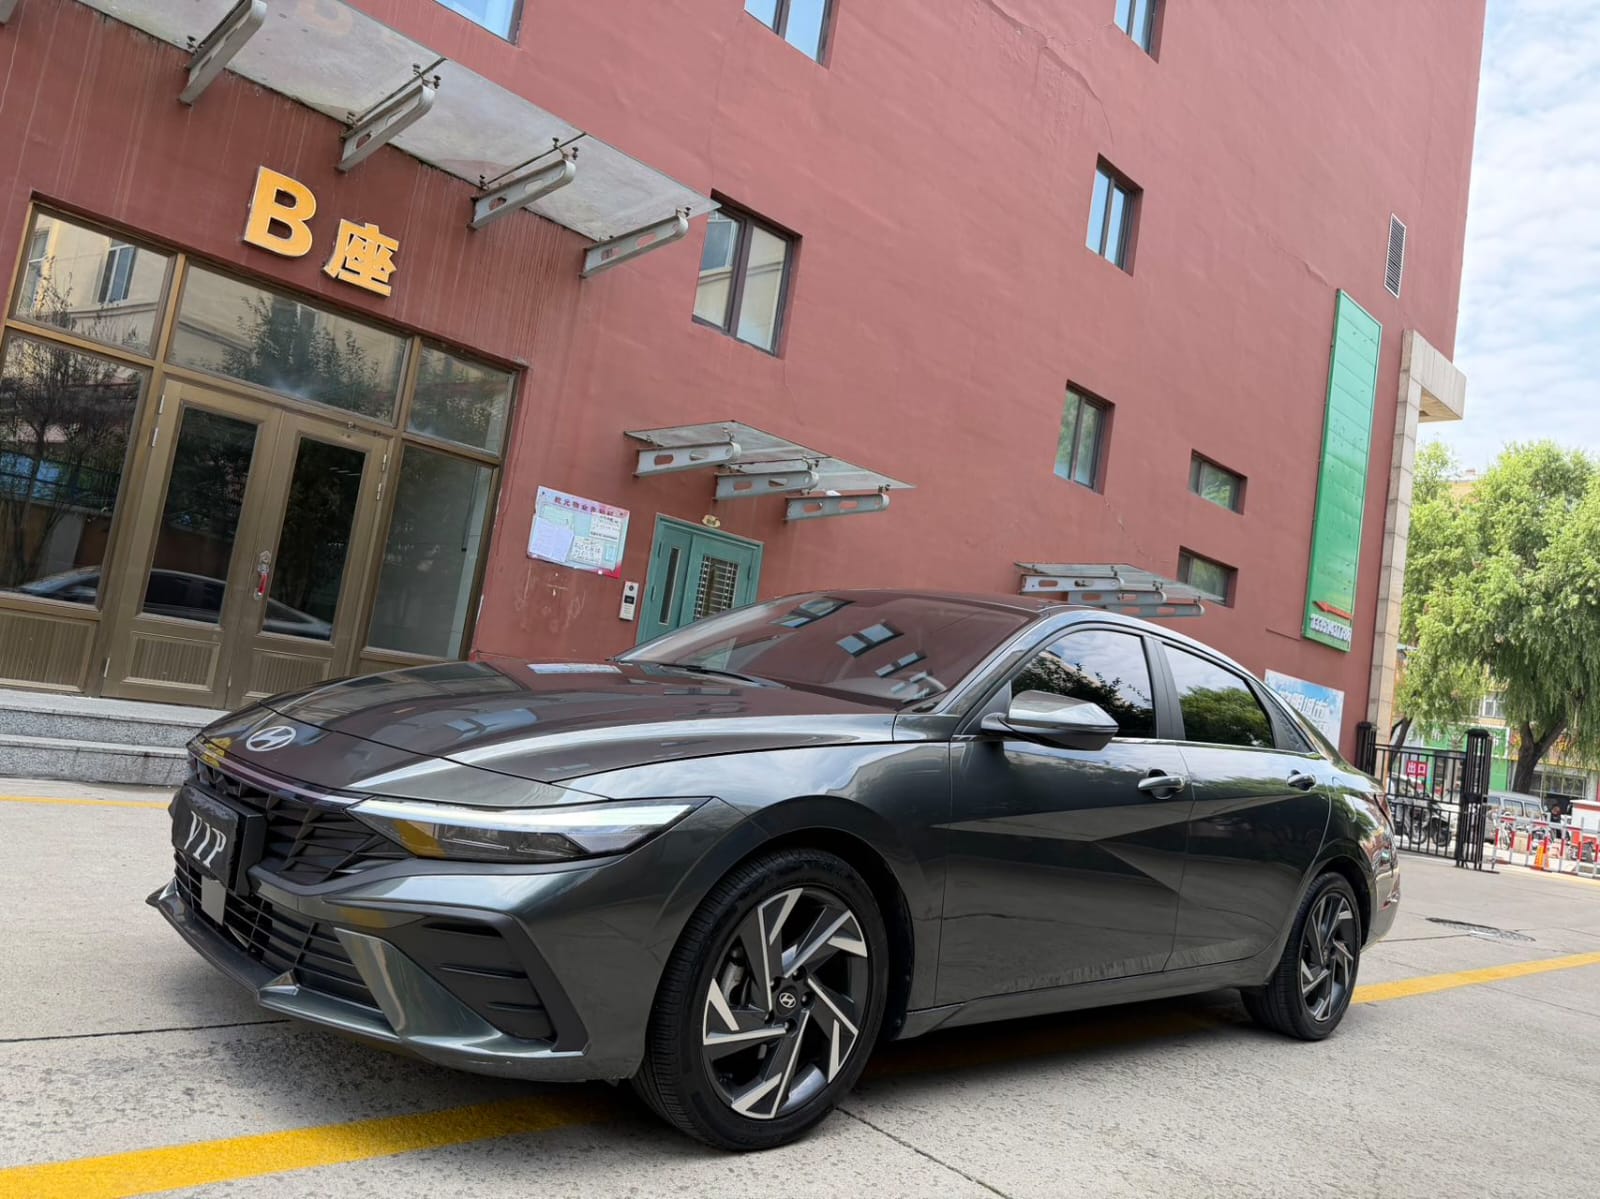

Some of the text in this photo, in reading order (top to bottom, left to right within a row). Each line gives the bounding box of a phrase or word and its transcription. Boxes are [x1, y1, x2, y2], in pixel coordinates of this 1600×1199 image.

[244, 165, 399, 297] B座
[1407, 761, 1426, 774] 出口
[184, 810, 227, 869] VIP
